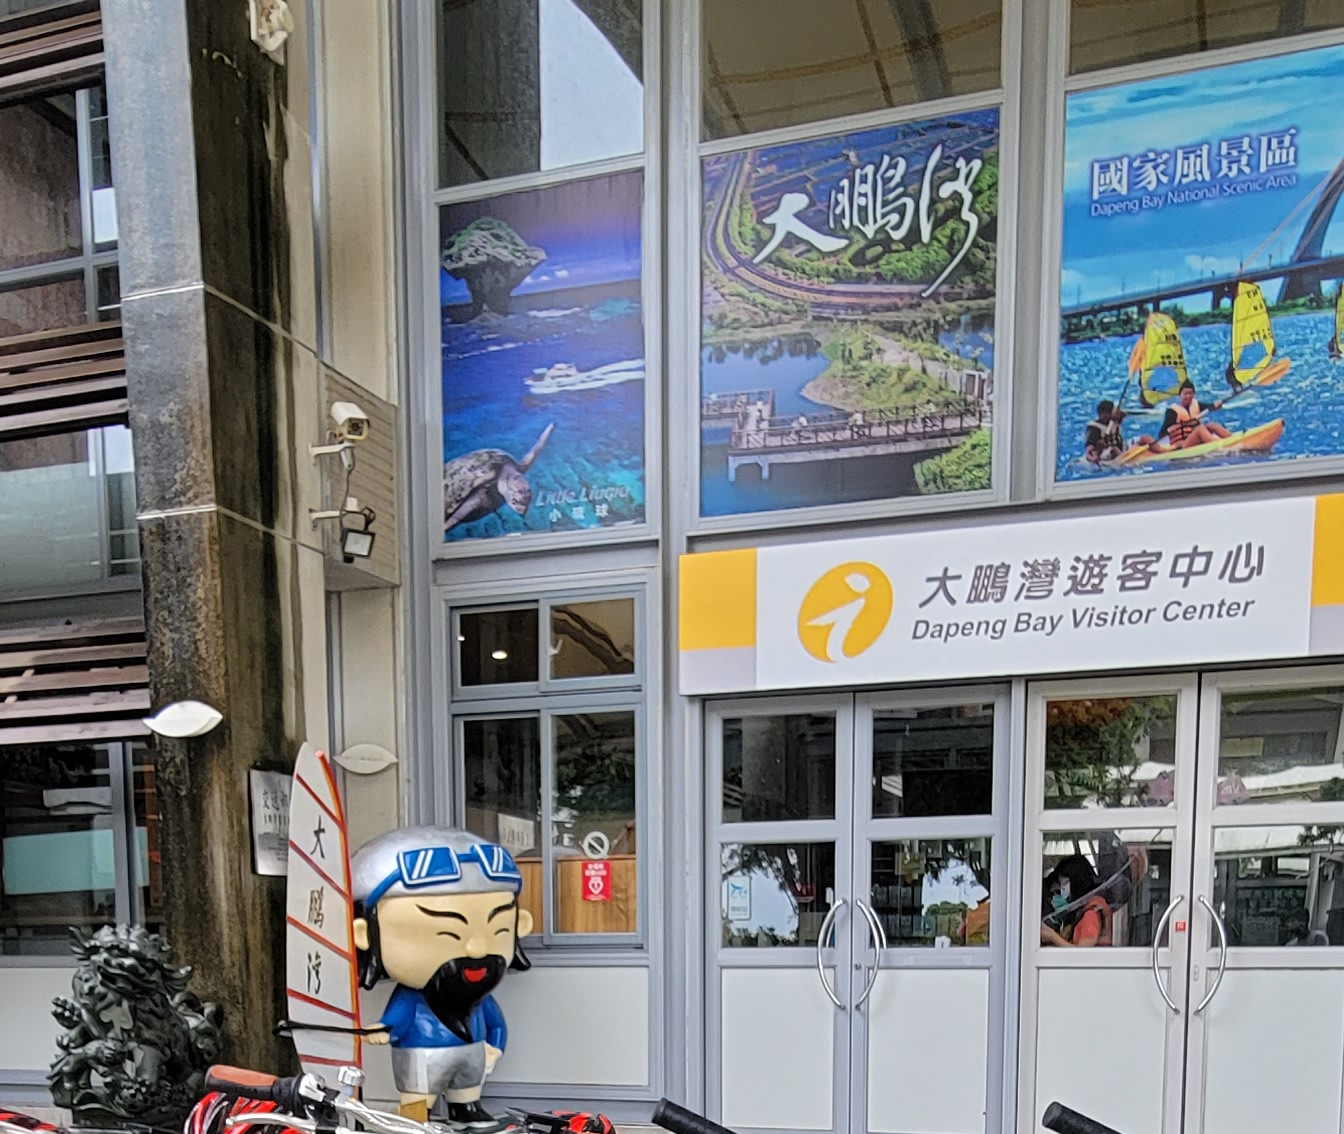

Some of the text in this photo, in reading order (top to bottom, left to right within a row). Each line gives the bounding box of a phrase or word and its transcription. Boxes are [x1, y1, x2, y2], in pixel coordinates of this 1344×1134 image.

[1092, 128, 1297, 200] 國家風景區
[1091, 173, 1296, 217] Dapeng Bay National Scenic Area
[918, 542, 1265, 609] 大鵬灣遊客中心
[911, 598, 1256, 643] Dapeng Bay Visitor Center
